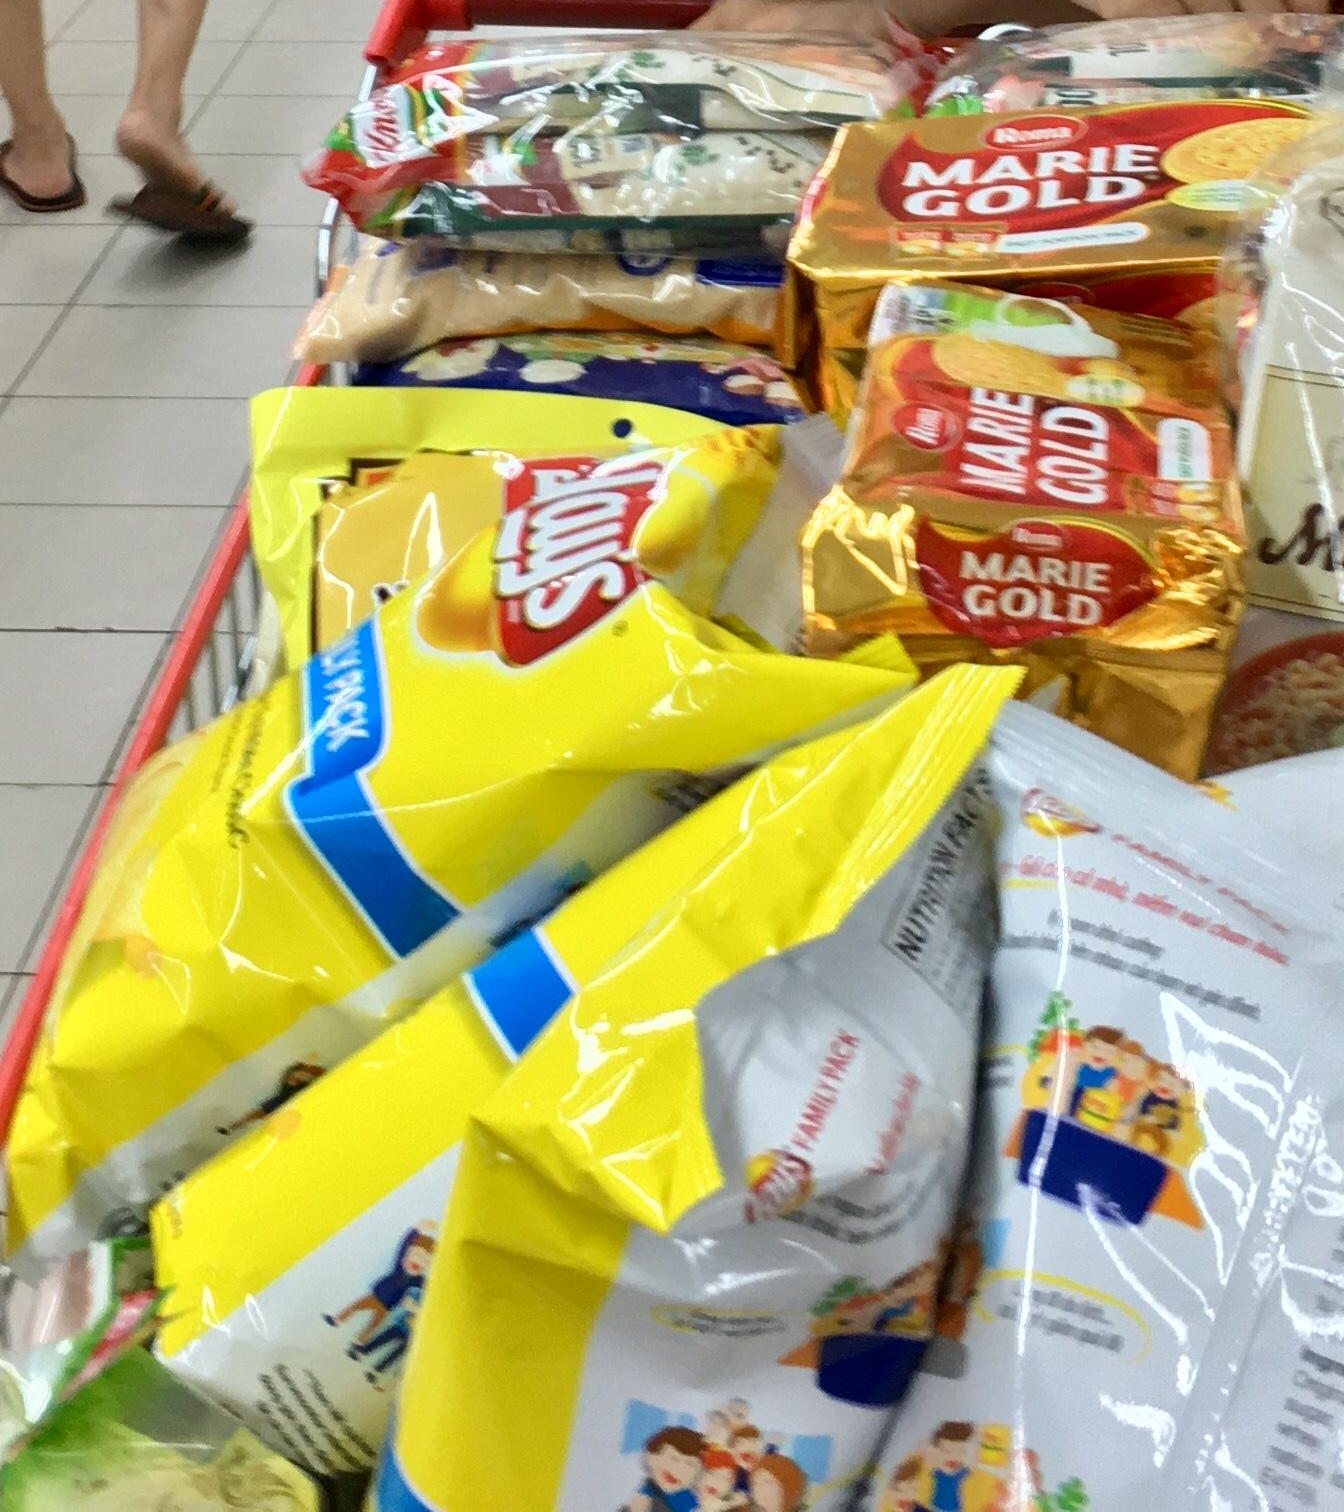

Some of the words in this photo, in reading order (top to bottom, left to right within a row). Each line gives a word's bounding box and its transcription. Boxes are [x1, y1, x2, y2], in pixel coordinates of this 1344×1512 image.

[900, 144, 1160, 188] MARIE
[902, 176, 1147, 217] GOLD
[957, 387, 1035, 496] MARIE
[1036, 405, 1109, 505] GOLD
[959, 550, 1113, 593] MARIE
[961, 583, 1104, 626] GOLD
[321, 669, 371, 753] PACK
